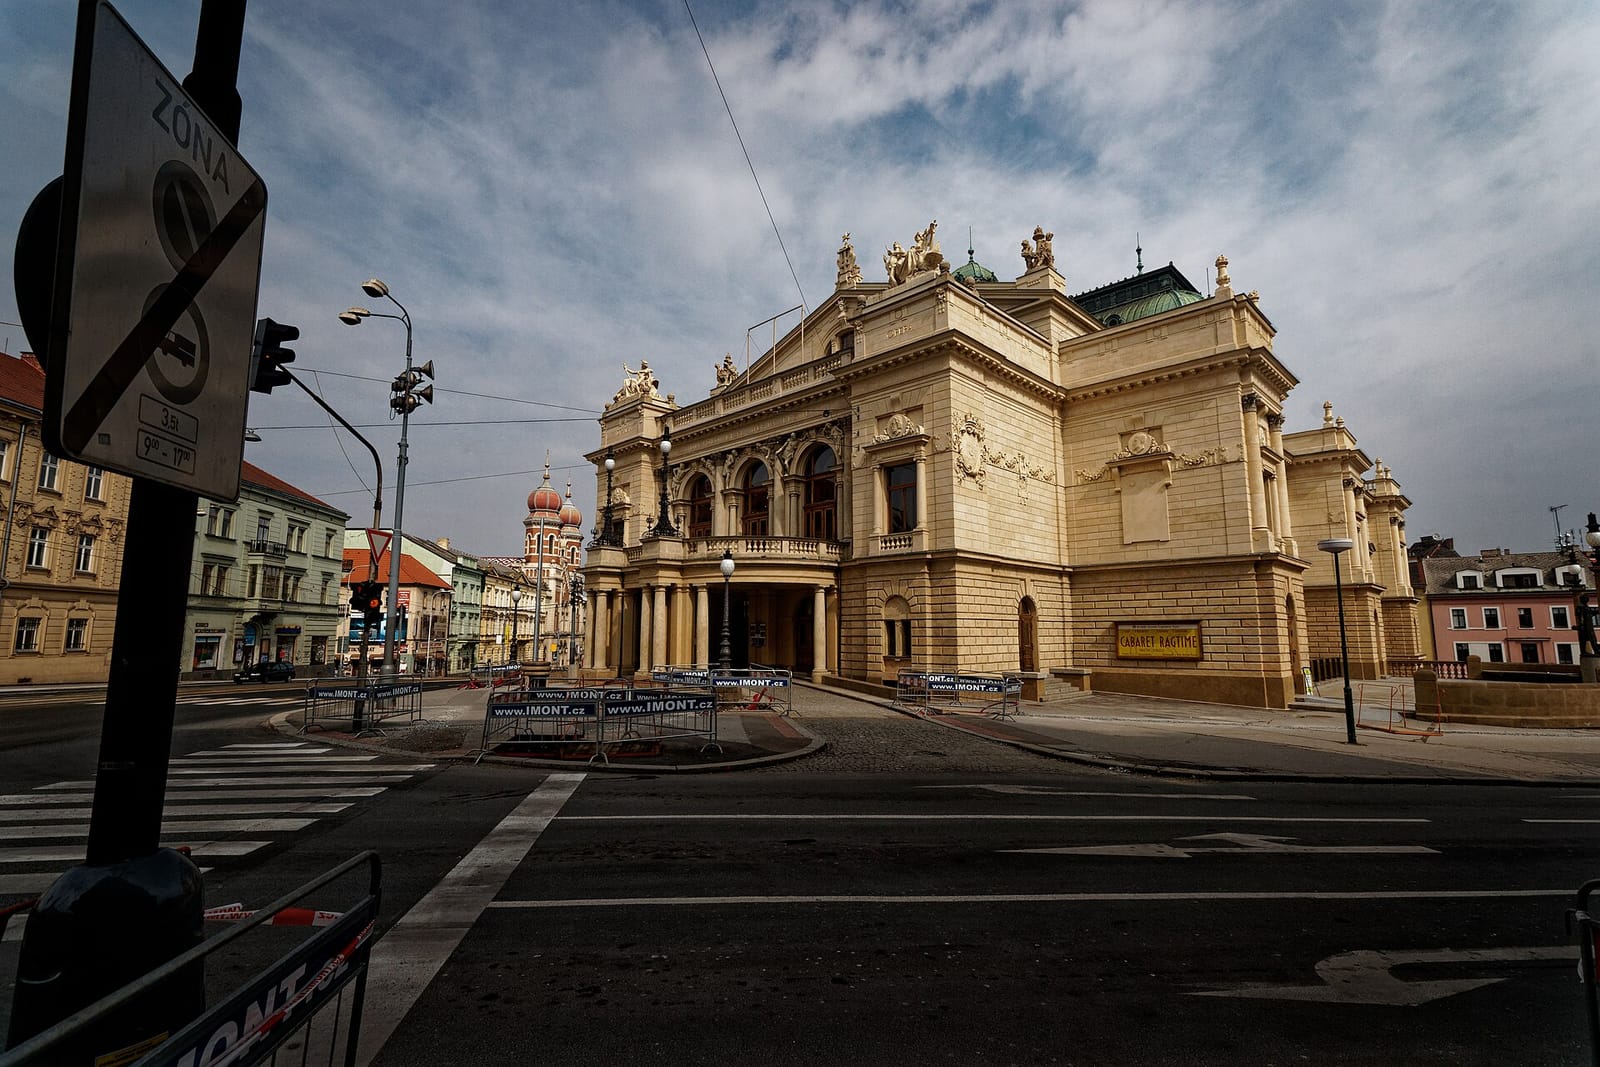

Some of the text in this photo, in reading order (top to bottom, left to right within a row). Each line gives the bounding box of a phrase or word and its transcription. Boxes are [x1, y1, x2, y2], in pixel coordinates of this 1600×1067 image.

[1120, 635, 1197, 649] CABARET RAGTIME
[715, 679, 784, 687] www.IMONT.cz
[931, 682, 999, 692] www.IMONT.cz
[318, 690, 367, 699] www.IMONT.cz
[376, 686, 420, 699] www.IMONT.cz
[495, 705, 586, 716] www.IMONT.cz
[606, 700, 713, 715] www.IMONT.cz
